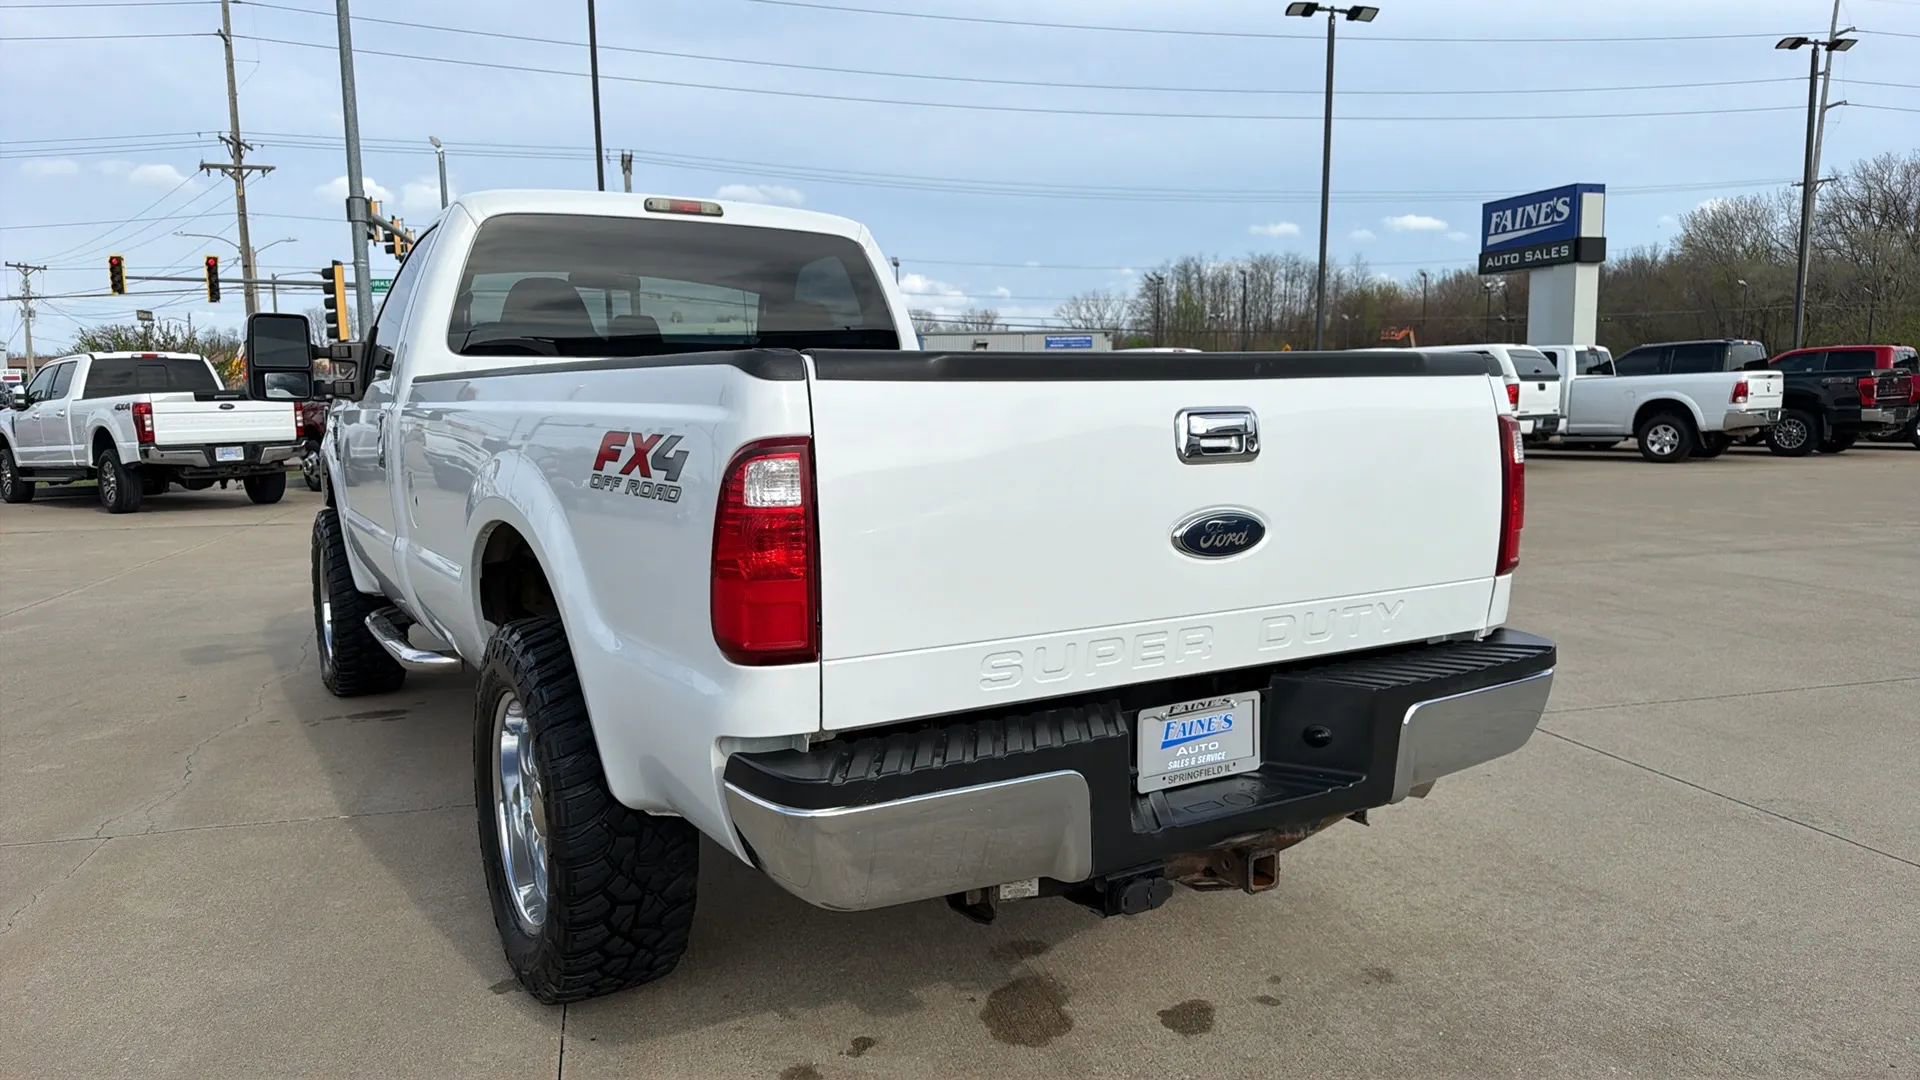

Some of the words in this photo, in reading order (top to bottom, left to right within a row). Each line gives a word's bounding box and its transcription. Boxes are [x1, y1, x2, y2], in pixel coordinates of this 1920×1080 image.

[1488, 197, 1570, 235] FAINE'S
[1486, 254, 1519, 267] AUTO
[1525, 245, 1569, 262] SALES
[593, 430, 690, 482] FX4
[590, 473, 622, 492] OFF
[625, 479, 682, 503] ROAD
[1200, 520, 1249, 548] Ford
[979, 625, 1214, 692] SUPER
[1258, 599, 1405, 651] DUTY
[1168, 697, 1231, 714] FAINE'S
[1163, 714, 1233, 741] FAINE'S
[1168, 757, 1190, 770] SALES
[1197, 751, 1226, 764] SERVICE
[1176, 742, 1219, 756] AUTO
[1168, 766, 1223, 784] SPRINGFIELD
[1222, 765, 1231, 773] IL
